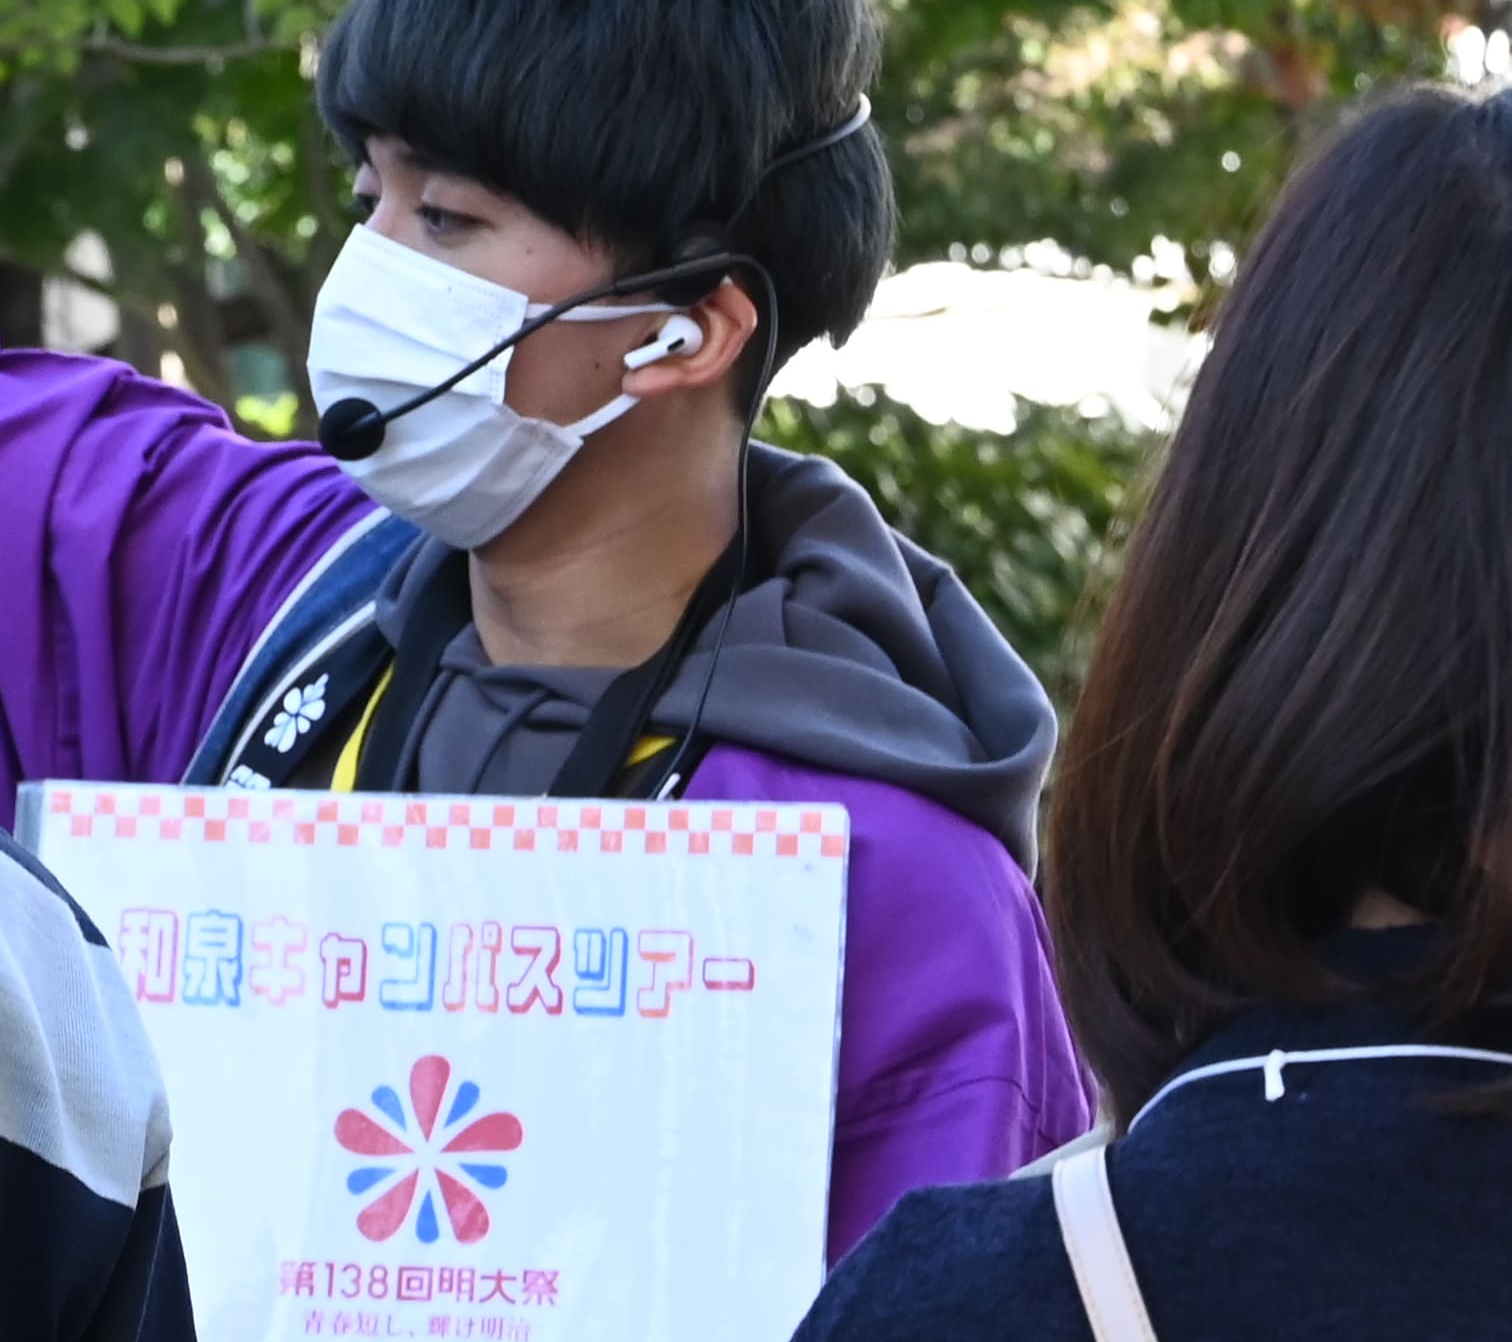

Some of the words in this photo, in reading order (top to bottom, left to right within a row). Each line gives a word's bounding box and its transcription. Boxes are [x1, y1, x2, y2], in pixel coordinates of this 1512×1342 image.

[118, 907, 755, 1018] 和泉キャンパスツアー
[278, 1261, 560, 1306] 第138回明大祭
